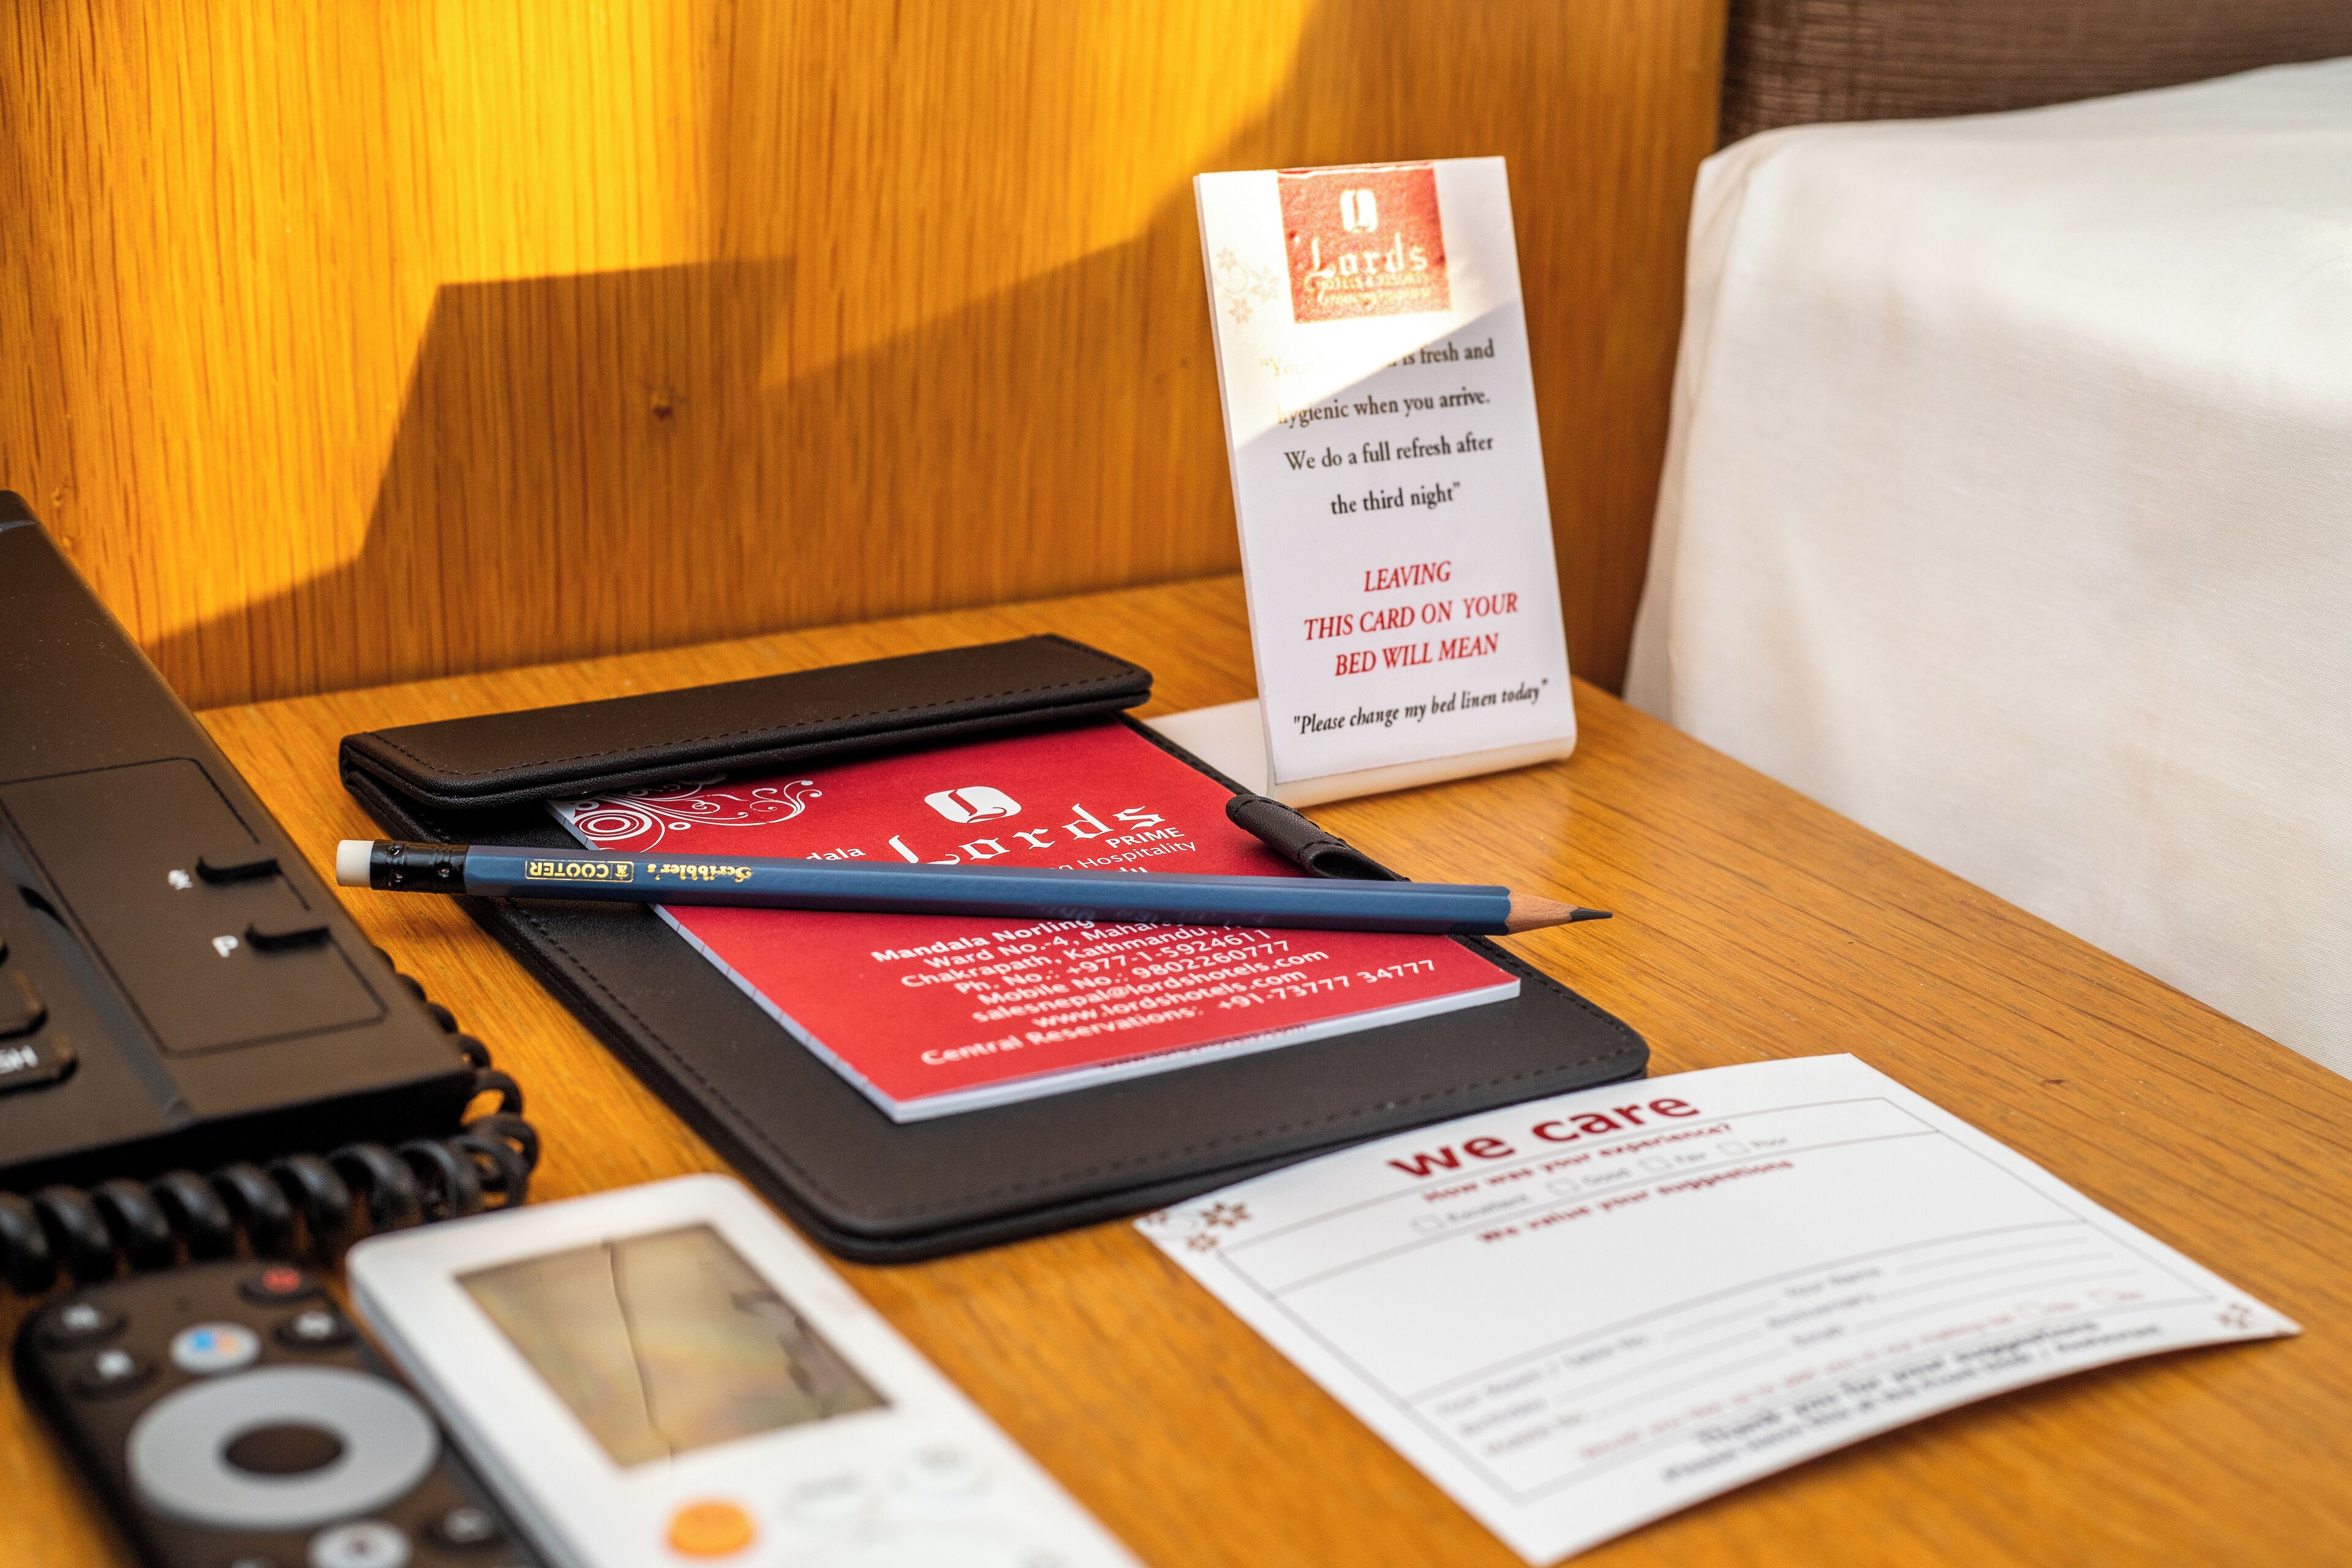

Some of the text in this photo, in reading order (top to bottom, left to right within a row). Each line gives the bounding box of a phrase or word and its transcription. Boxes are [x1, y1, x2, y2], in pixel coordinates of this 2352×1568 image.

[1304, 232, 1428, 284] Lords
[1402, 353, 1415, 367] is
[1420, 341, 1460, 367] fresh
[1463, 338, 1495, 361] and
[1353, 394, 1399, 416] when
[1404, 397, 1434, 418] you
[1439, 387, 1491, 409] arrive.
[1284, 431, 1494, 471] We do a full refresh after
[1330, 496, 1357, 516] the
[1362, 486, 1404, 511] third
[1363, 560, 1452, 593] LEAVING
[1303, 592, 1519, 641] THIS CARD ON YOUR
[1334, 632, 1500, 676] BED WILL MEAN
[1293, 712, 1345, 735] "Please
[1349, 704, 1400, 728] change
[1404, 704, 1427, 722] my
[1431, 695, 1457, 715] bed
[1460, 690, 1498, 710] linen
[806, 803, 1167, 865] dala Lords
[1076, 841, 1197, 869] Hospitality
[1105, 827, 1186, 849] PRIME
[529, 861, 752, 883] Scribbler's COOTER
[870, 919, 1096, 963] Mandala Norling
[900, 927, 1218, 988] Chakrapath, Kathmandu,
[922, 948, 995, 969] Ward
[954, 980, 1001, 995] Ph.
[1066, 929, 1270, 975] +977-1-5924611
[972, 951, 1329, 1023] salesnepal@lordshotels.com
[977, 982, 1071, 1006] Mobile
[1131, 940, 1289, 979] 9802260777
[921, 959, 1435, 1066] Central Reservations: +91-73777 34777
[1032, 970, 1308, 1029] www.lordshotels.com
[1385, 1098, 1701, 1178] we care
